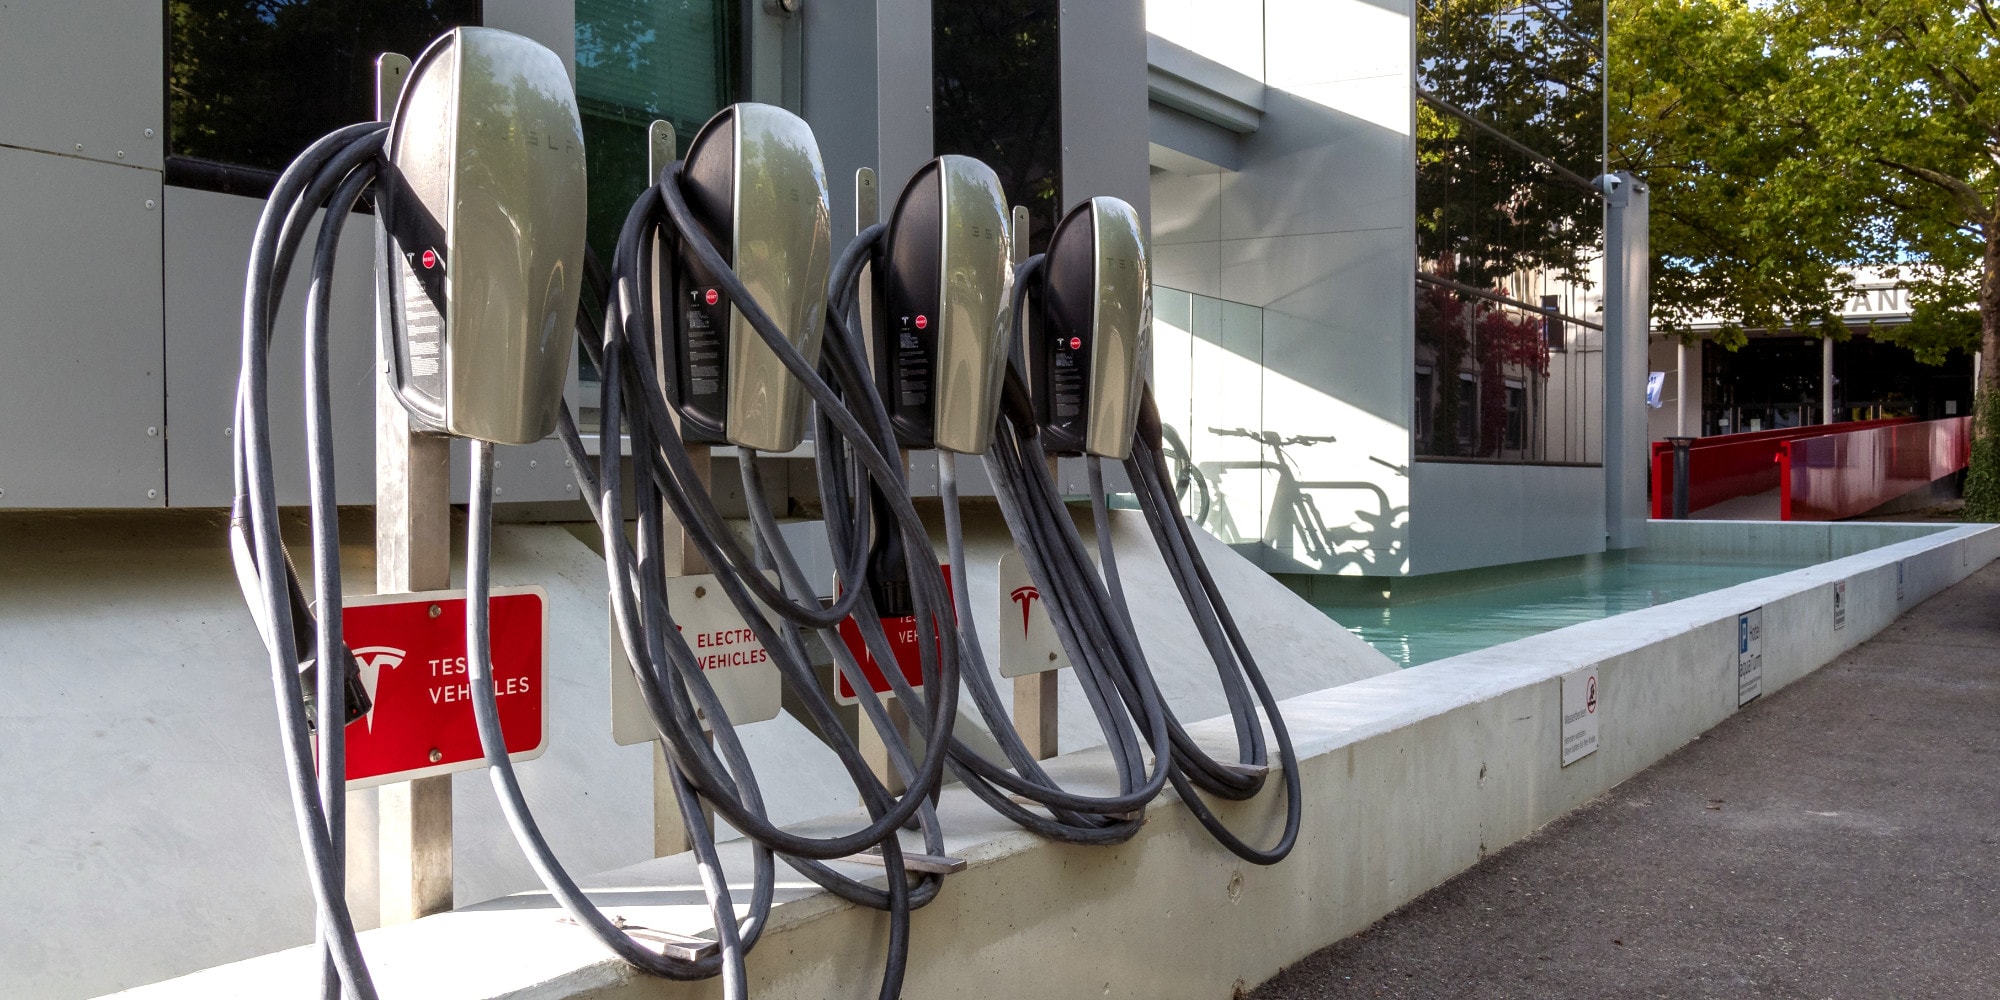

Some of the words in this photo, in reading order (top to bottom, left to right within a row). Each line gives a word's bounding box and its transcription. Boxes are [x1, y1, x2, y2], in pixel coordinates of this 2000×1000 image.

[394, 67, 400, 75] 1
[661, 133, 668, 141] 2
[697, 628, 758, 648] ELECTRI
[1742, 623, 1747, 650] P
[428, 657, 495, 677] TES
[697, 648, 767, 671] VEHICLES
[428, 676, 530, 704] VEHLES
